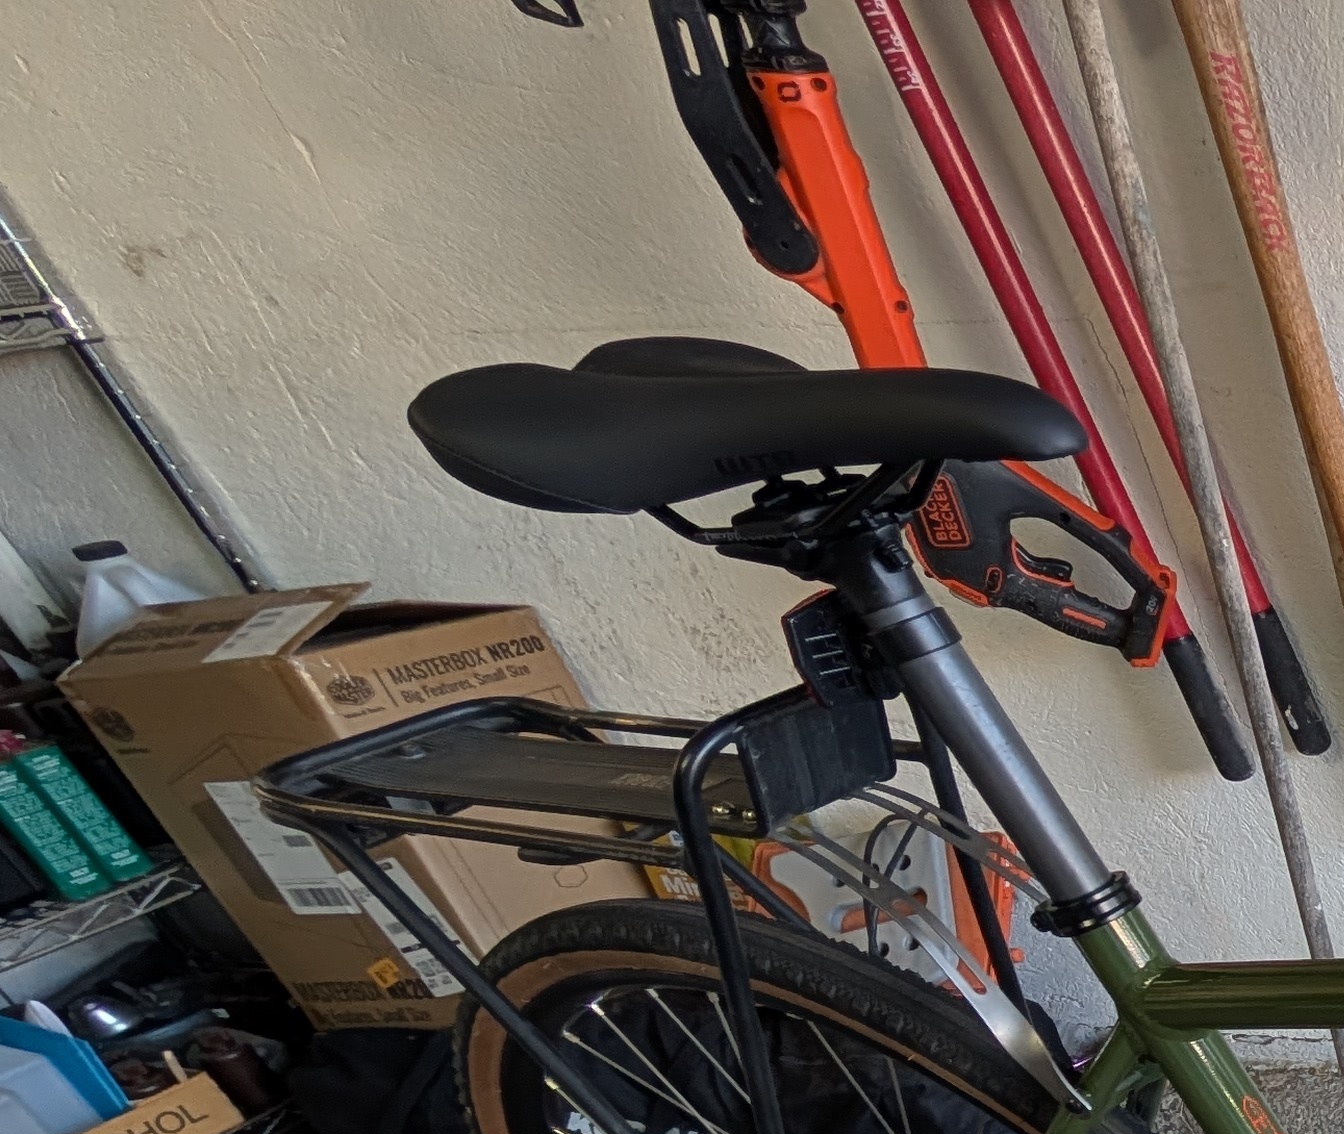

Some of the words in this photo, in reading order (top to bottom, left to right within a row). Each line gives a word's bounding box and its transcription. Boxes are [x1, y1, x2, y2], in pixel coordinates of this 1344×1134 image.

[934, 483, 963, 540] DECKER
[386, 648, 488, 686] MASTERBOX
[484, 634, 546, 665] NR200
[400, 688, 424, 705] Big
[422, 676, 477, 699] Features,
[475, 666, 507, 686] Small
[505, 663, 531, 680] Size
